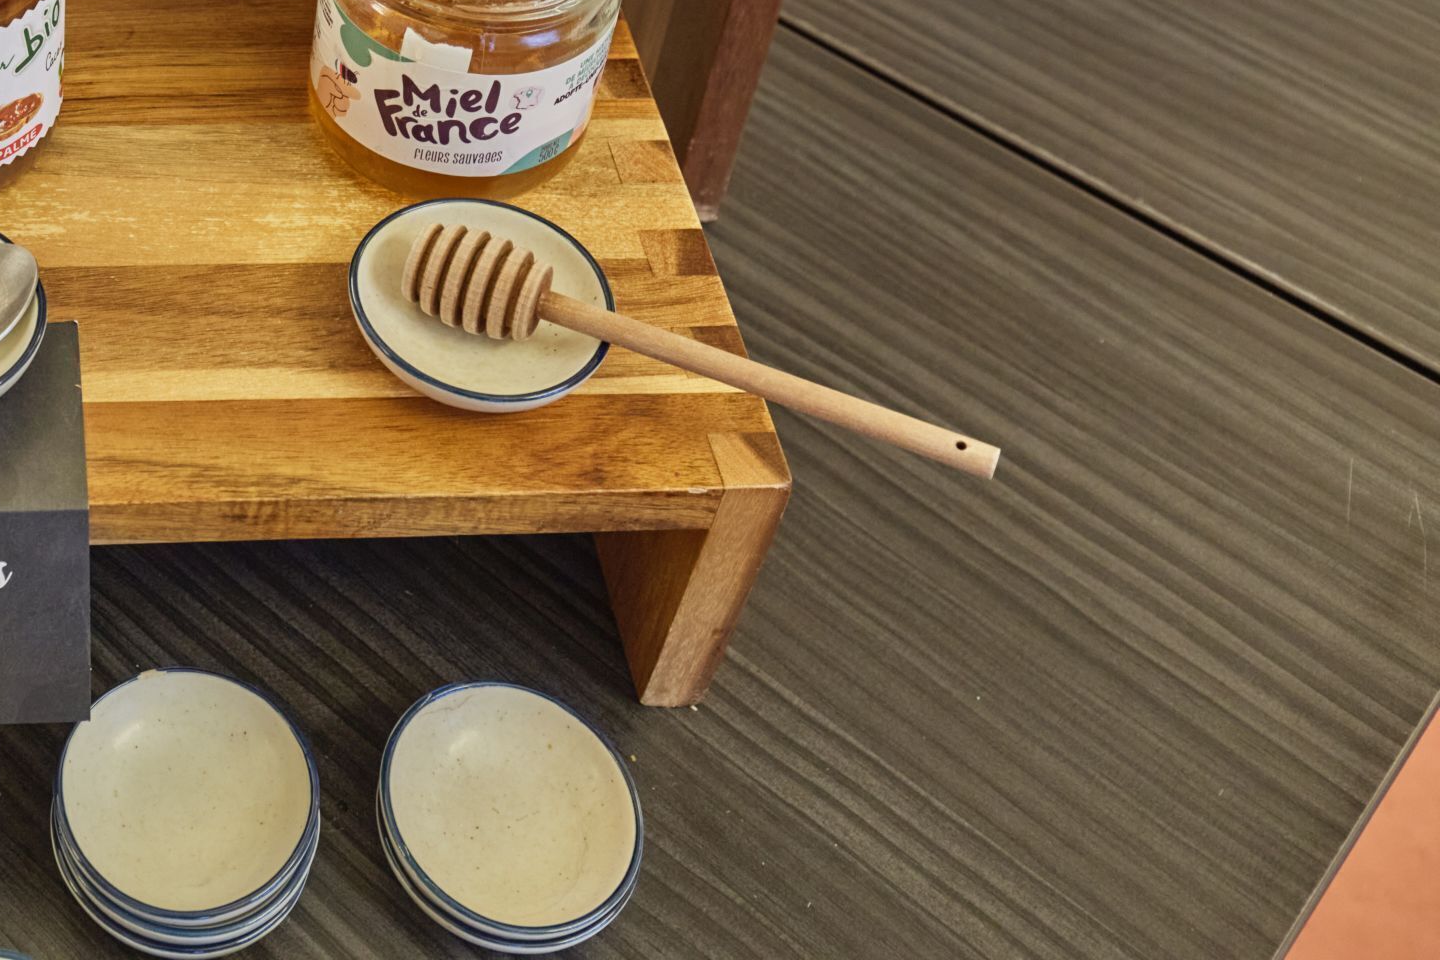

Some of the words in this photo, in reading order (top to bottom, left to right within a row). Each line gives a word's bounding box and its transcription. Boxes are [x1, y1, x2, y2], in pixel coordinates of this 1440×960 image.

[15, 0, 60, 74] bio
[374, 88, 522, 146] France
[402, 73, 501, 117] Miel
[412, 104, 429, 118] de
